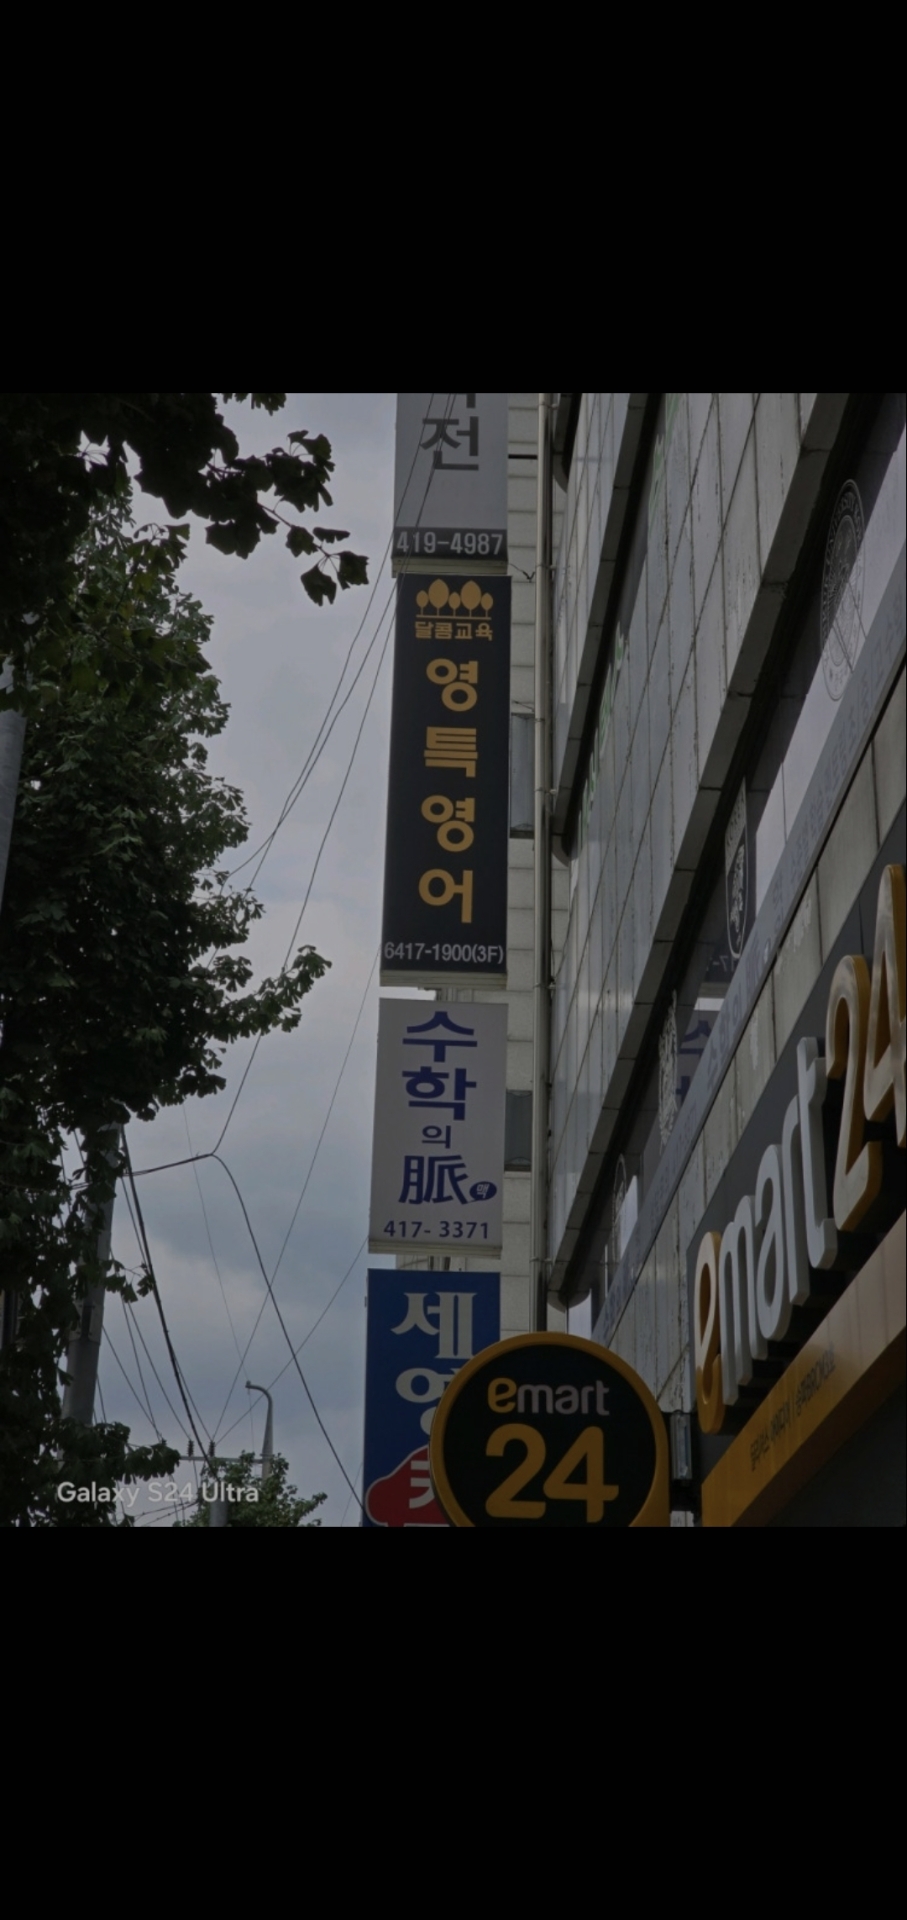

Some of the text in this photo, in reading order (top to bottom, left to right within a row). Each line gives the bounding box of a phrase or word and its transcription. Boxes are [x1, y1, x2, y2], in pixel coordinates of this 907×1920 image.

[420, 393, 479, 471] 전
[396, 530, 503, 555] 419-4987
[414, 621, 493, 641] 달콤교육
[383, 941, 505, 966] 6417-1900(3F)
[487, 1376, 610, 1416] emart
[484, 1422, 620, 1524] 24
